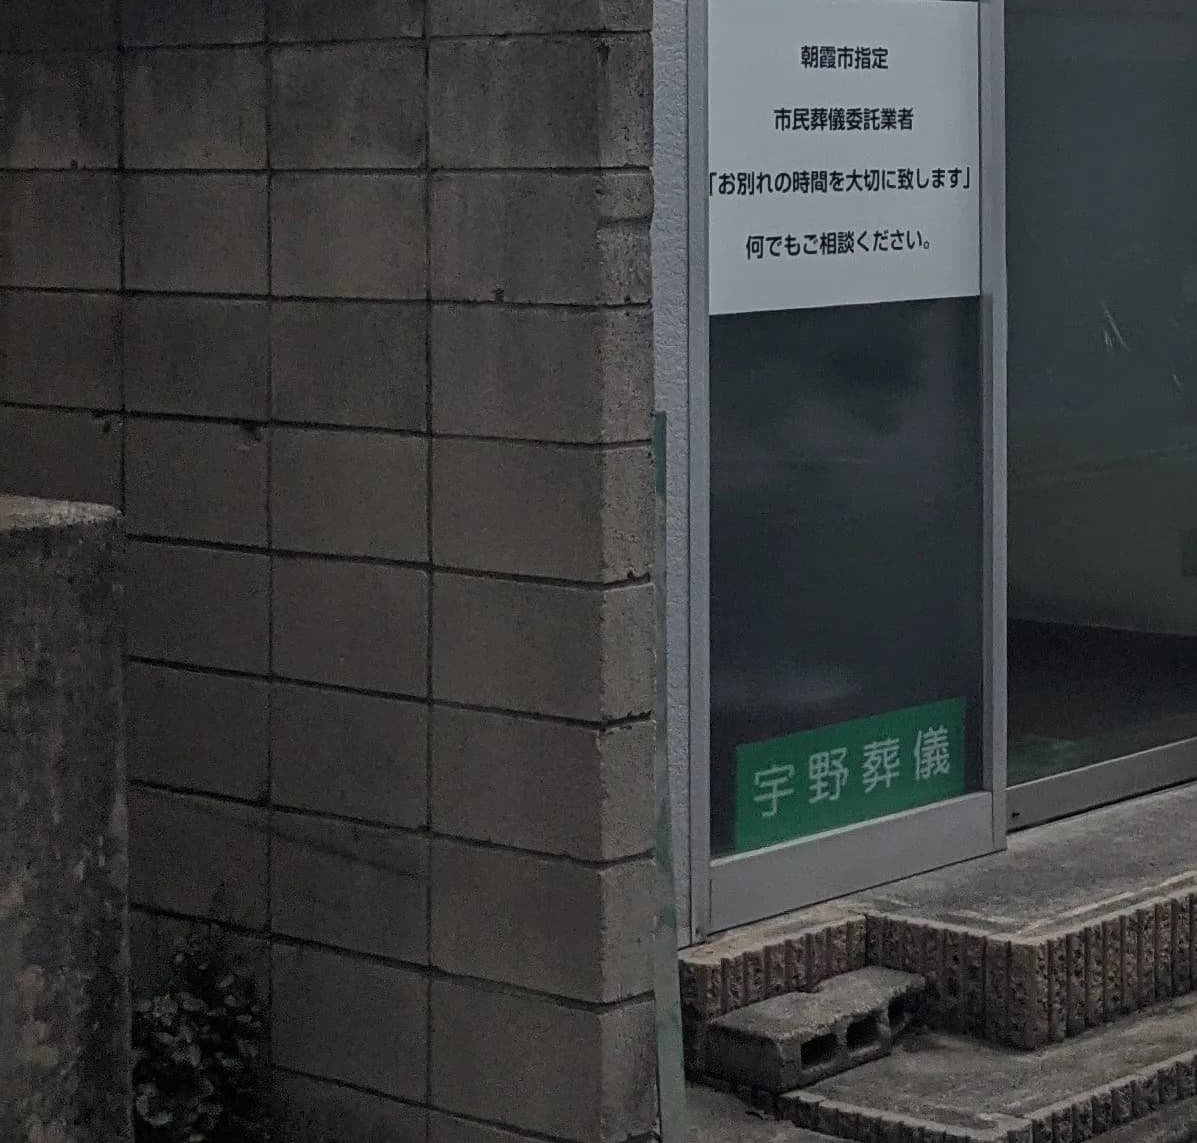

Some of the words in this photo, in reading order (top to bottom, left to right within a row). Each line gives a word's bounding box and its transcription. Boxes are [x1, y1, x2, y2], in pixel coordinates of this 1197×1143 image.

[800, 46, 889, 70] 朝霞市指定
[774, 107, 914, 131] 市民葬儀委託業者
[709, 167, 971, 196] 「お別れの時間を大切に致します」
[745, 230, 930, 260] 何でもご相談ください。
[753, 725, 950, 818] 宇野葬儀
